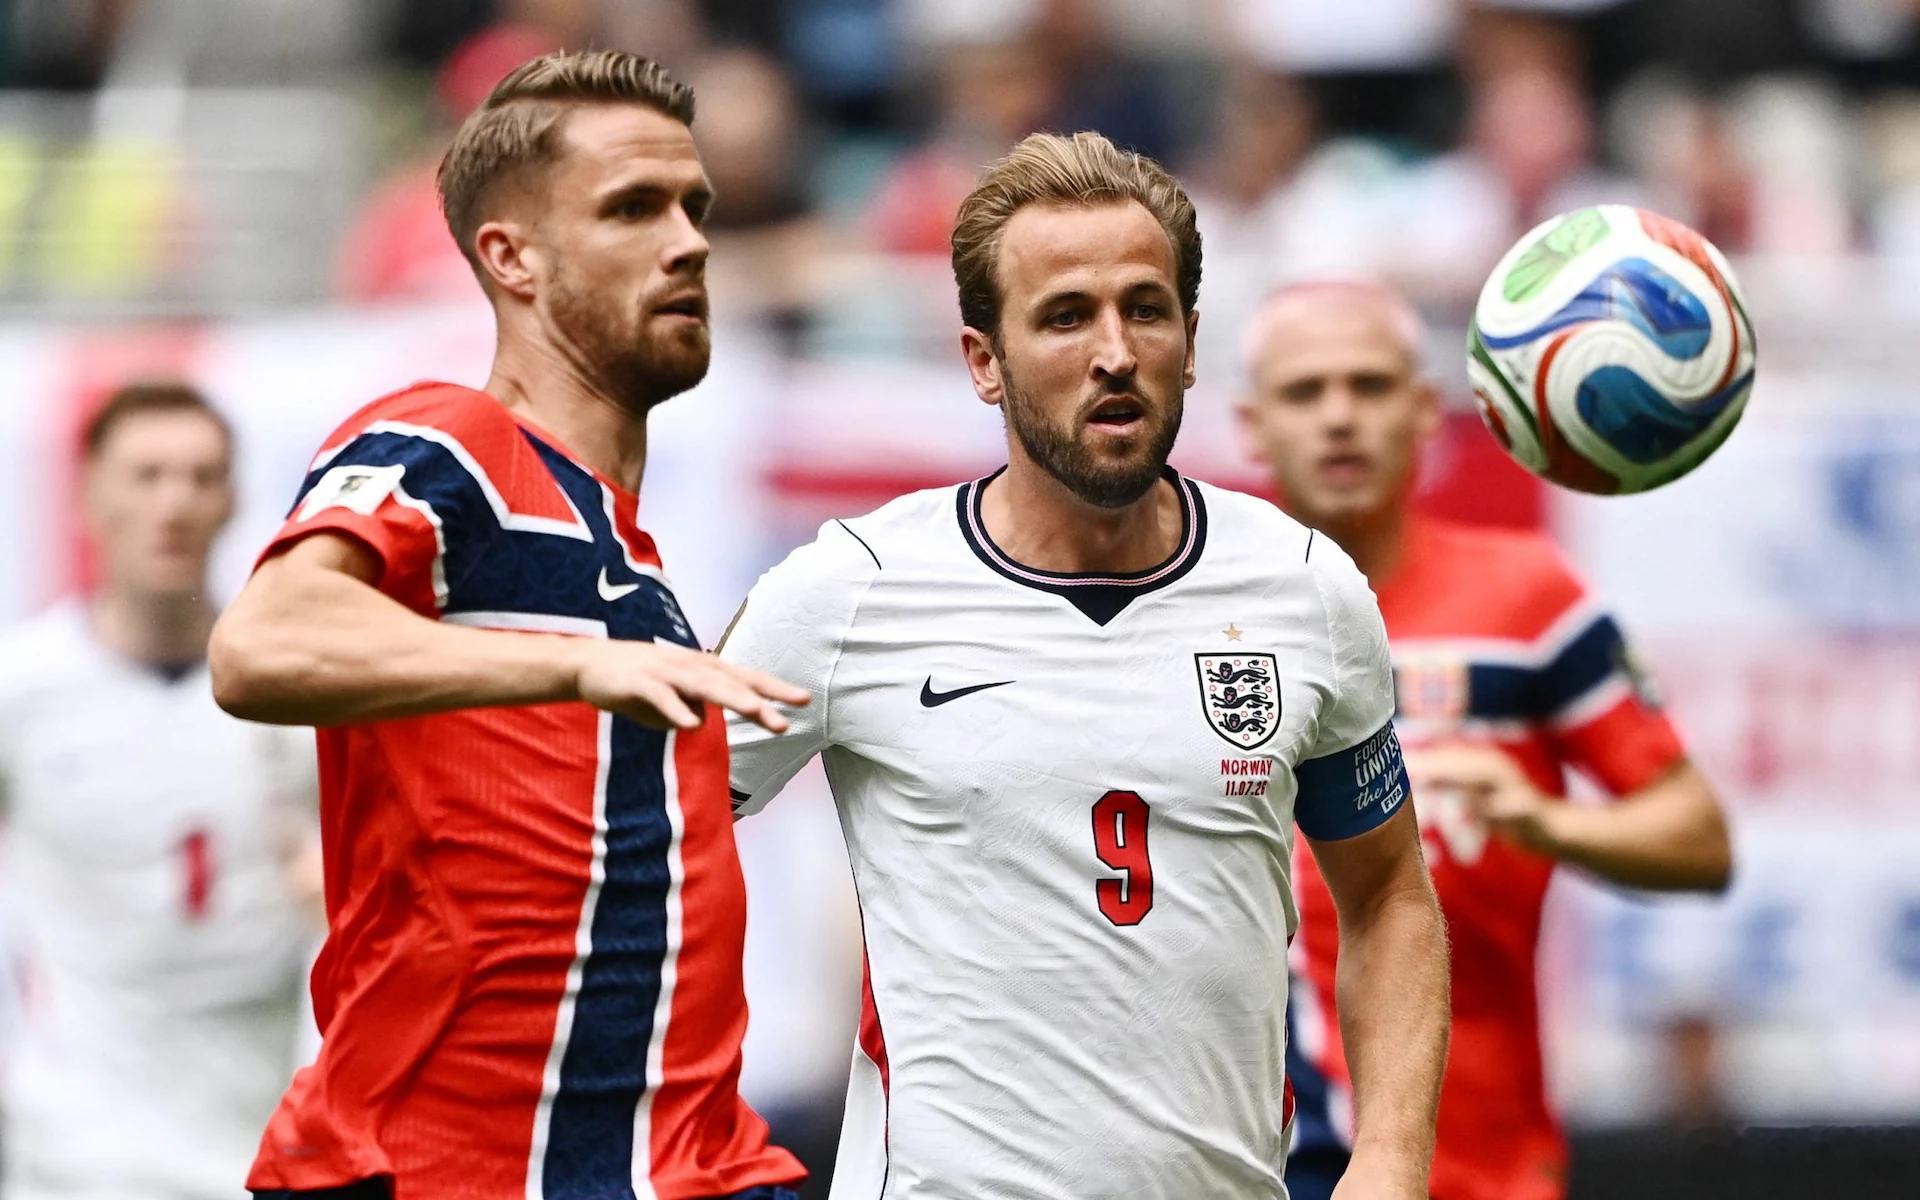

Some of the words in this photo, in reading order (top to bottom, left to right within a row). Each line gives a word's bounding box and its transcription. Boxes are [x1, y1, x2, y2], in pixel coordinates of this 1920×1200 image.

[1355, 722, 1392, 766] FOOTB
[1221, 759, 1273, 776] NORWAY
[1356, 728, 1399, 788] UNITES
[1225, 780, 1268, 796] 11.07.26
[1353, 787, 1383, 811] the
[1383, 786, 1402, 811] FIFA
[1092, 790, 1154, 926] 9
